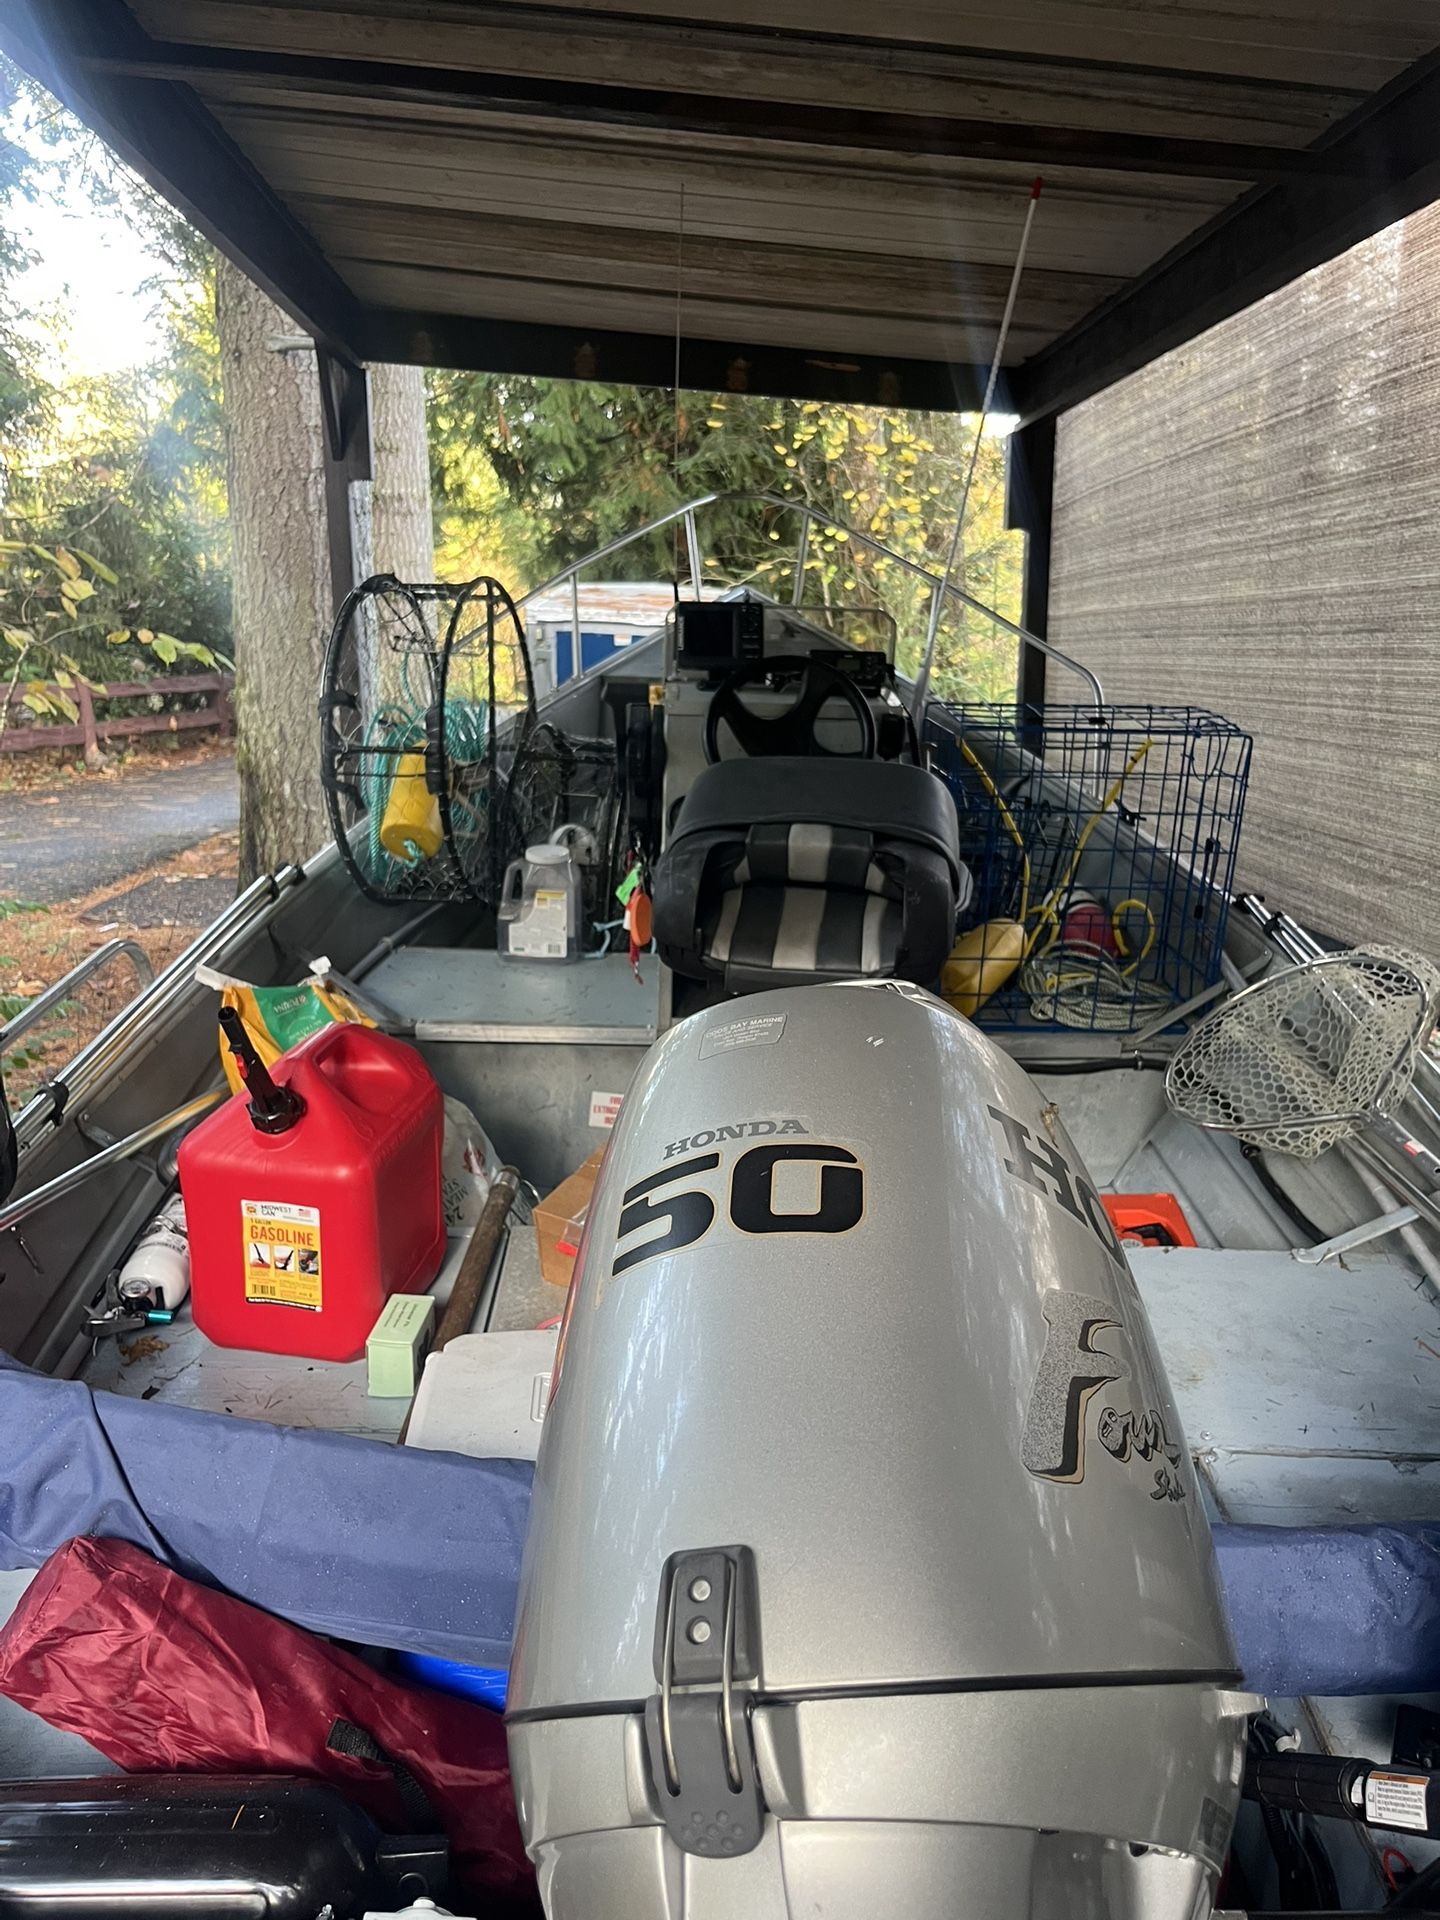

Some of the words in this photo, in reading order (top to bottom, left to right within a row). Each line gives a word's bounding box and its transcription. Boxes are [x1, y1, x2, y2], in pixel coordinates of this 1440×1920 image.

[731, 1021, 748, 1030] BAY
[750, 1017, 783, 1025] MARINE
[663, 1119, 809, 1160] HONDA
[260, 1204, 292, 1213] MIDWEST
[612, 1144, 863, 1276] 50
[250, 1225, 314, 1247] GASOLINE
